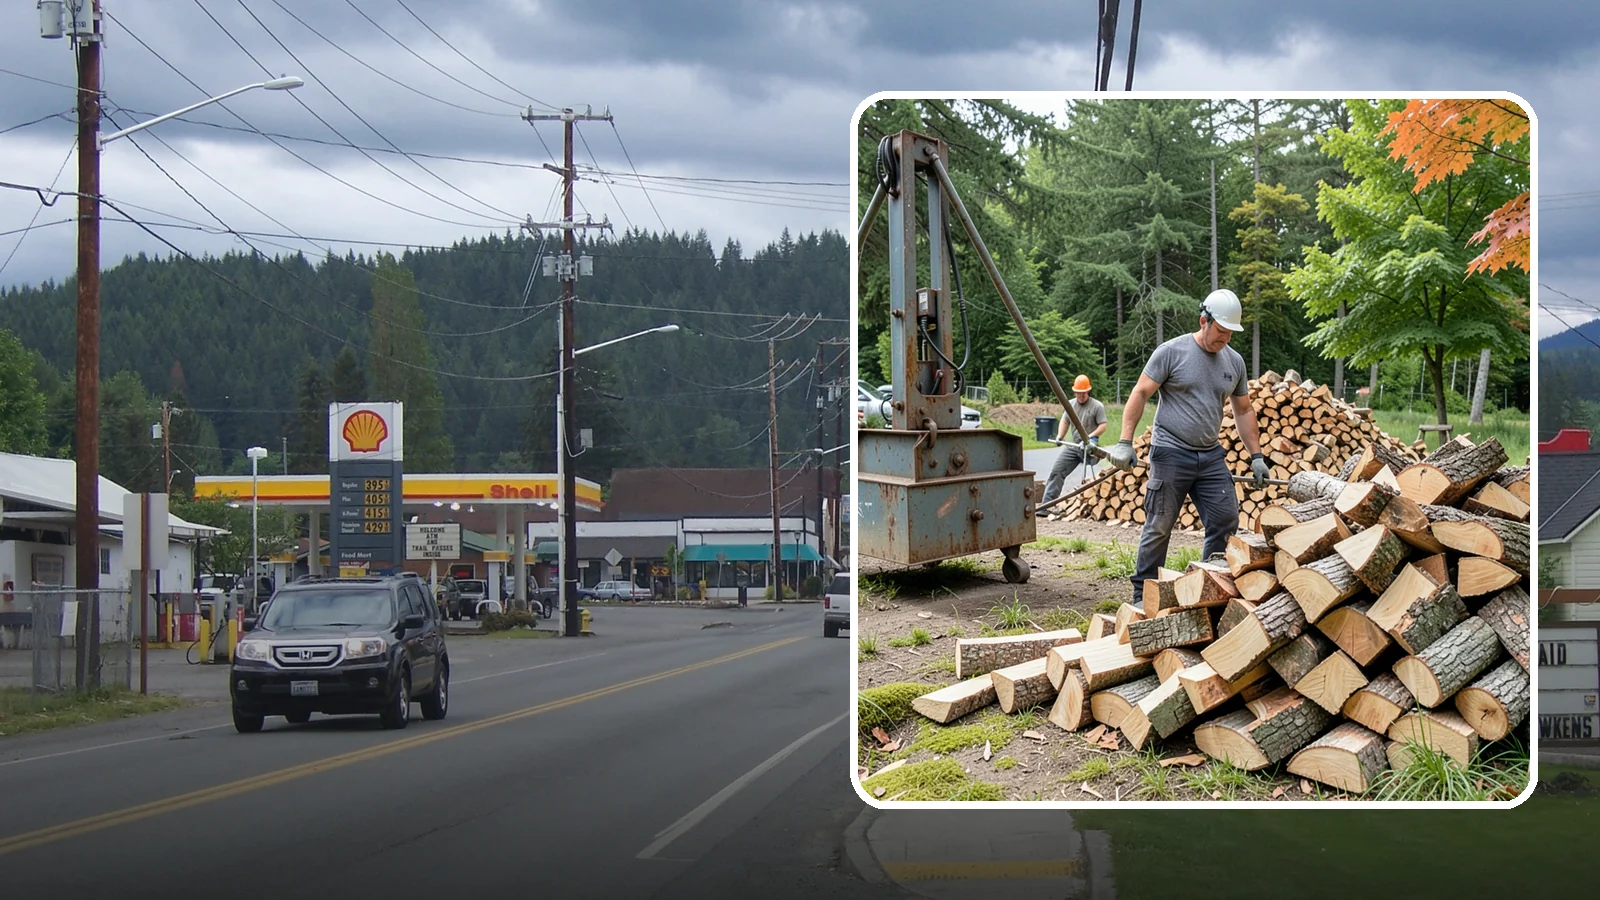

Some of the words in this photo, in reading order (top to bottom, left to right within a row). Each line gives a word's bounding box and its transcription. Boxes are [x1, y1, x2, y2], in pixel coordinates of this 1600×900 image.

[365, 480, 384, 490] 395
[490, 484, 547, 499] Shell
[365, 494, 384, 504] 405
[365, 508, 384, 518] 415
[365, 522, 384, 532] 429
